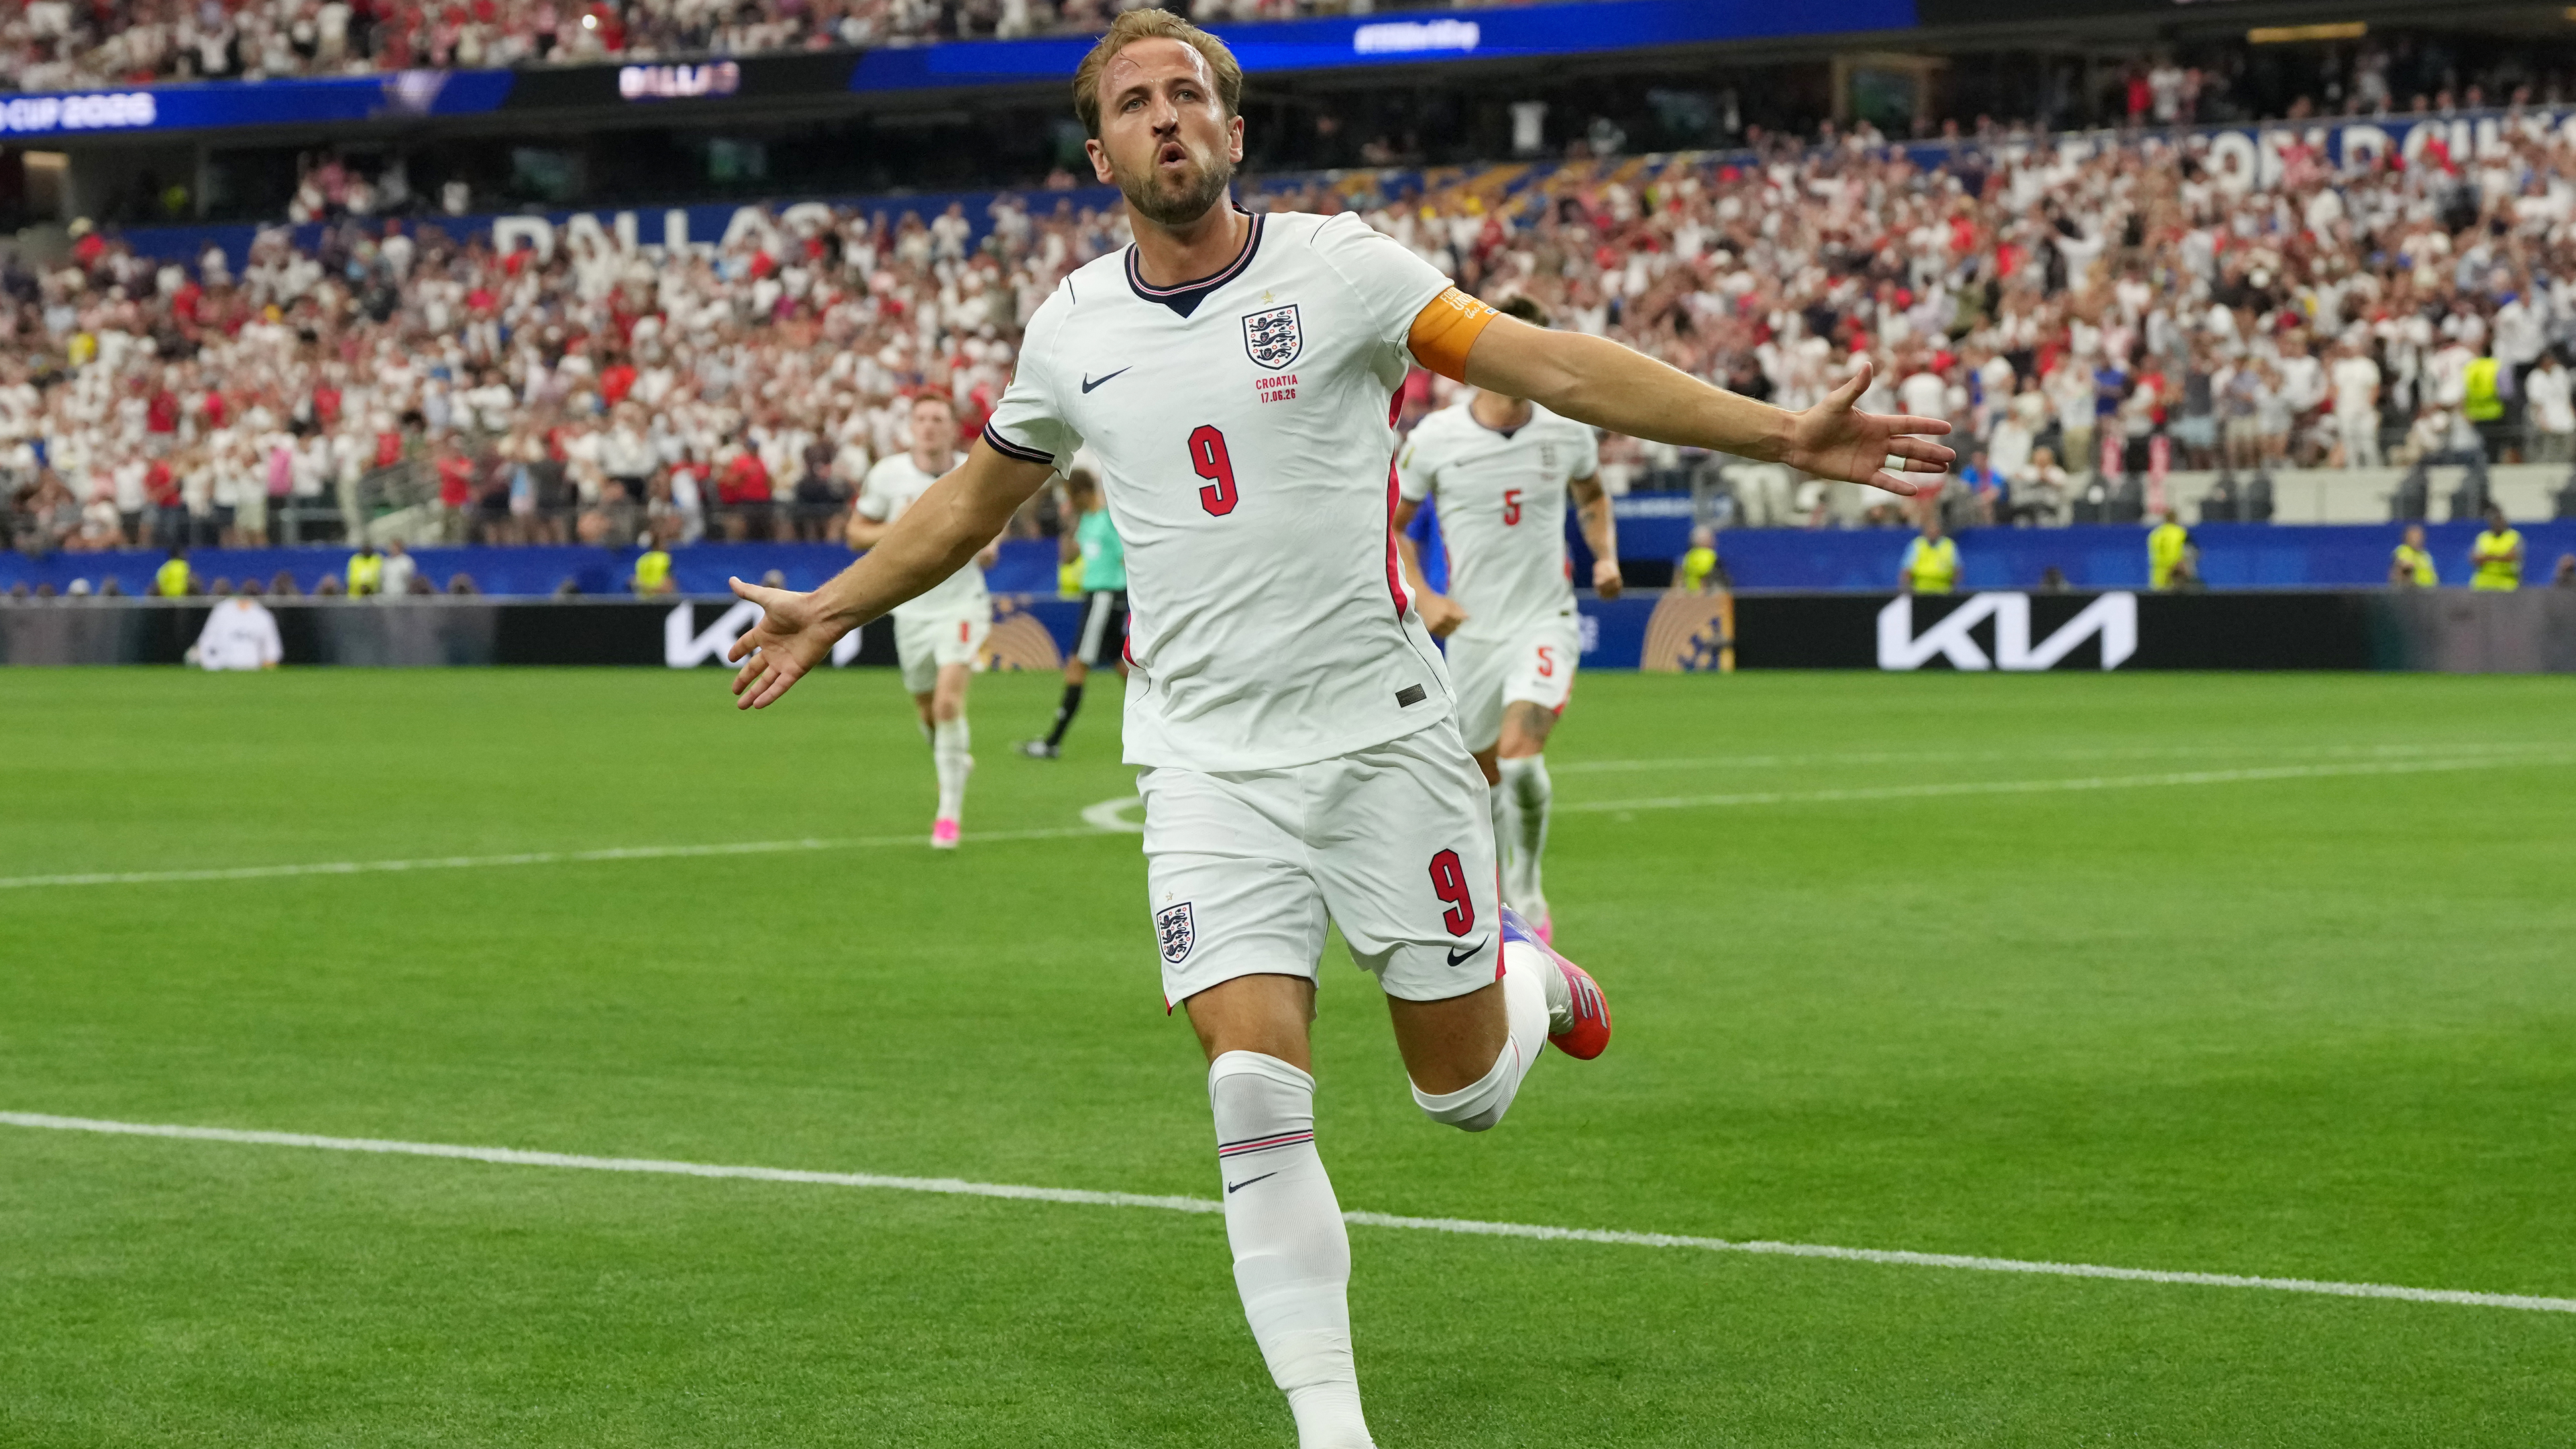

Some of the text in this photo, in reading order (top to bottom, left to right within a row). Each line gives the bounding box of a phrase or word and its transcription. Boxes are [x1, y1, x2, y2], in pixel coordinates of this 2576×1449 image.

[8, 98, 58, 131] CUP
[62, 92, 157, 129] 2026
[1464, 307, 1480, 319] the
[1256, 374, 1298, 390] CROATIA
[1260, 388, 1296, 404] 17.06.26
[1187, 424, 1238, 517] 9
[1504, 488, 1521, 525] 5
[1878, 592, 2137, 670] KIA
[1538, 645, 1553, 678] 5
[1428, 848, 1475, 938] 9
